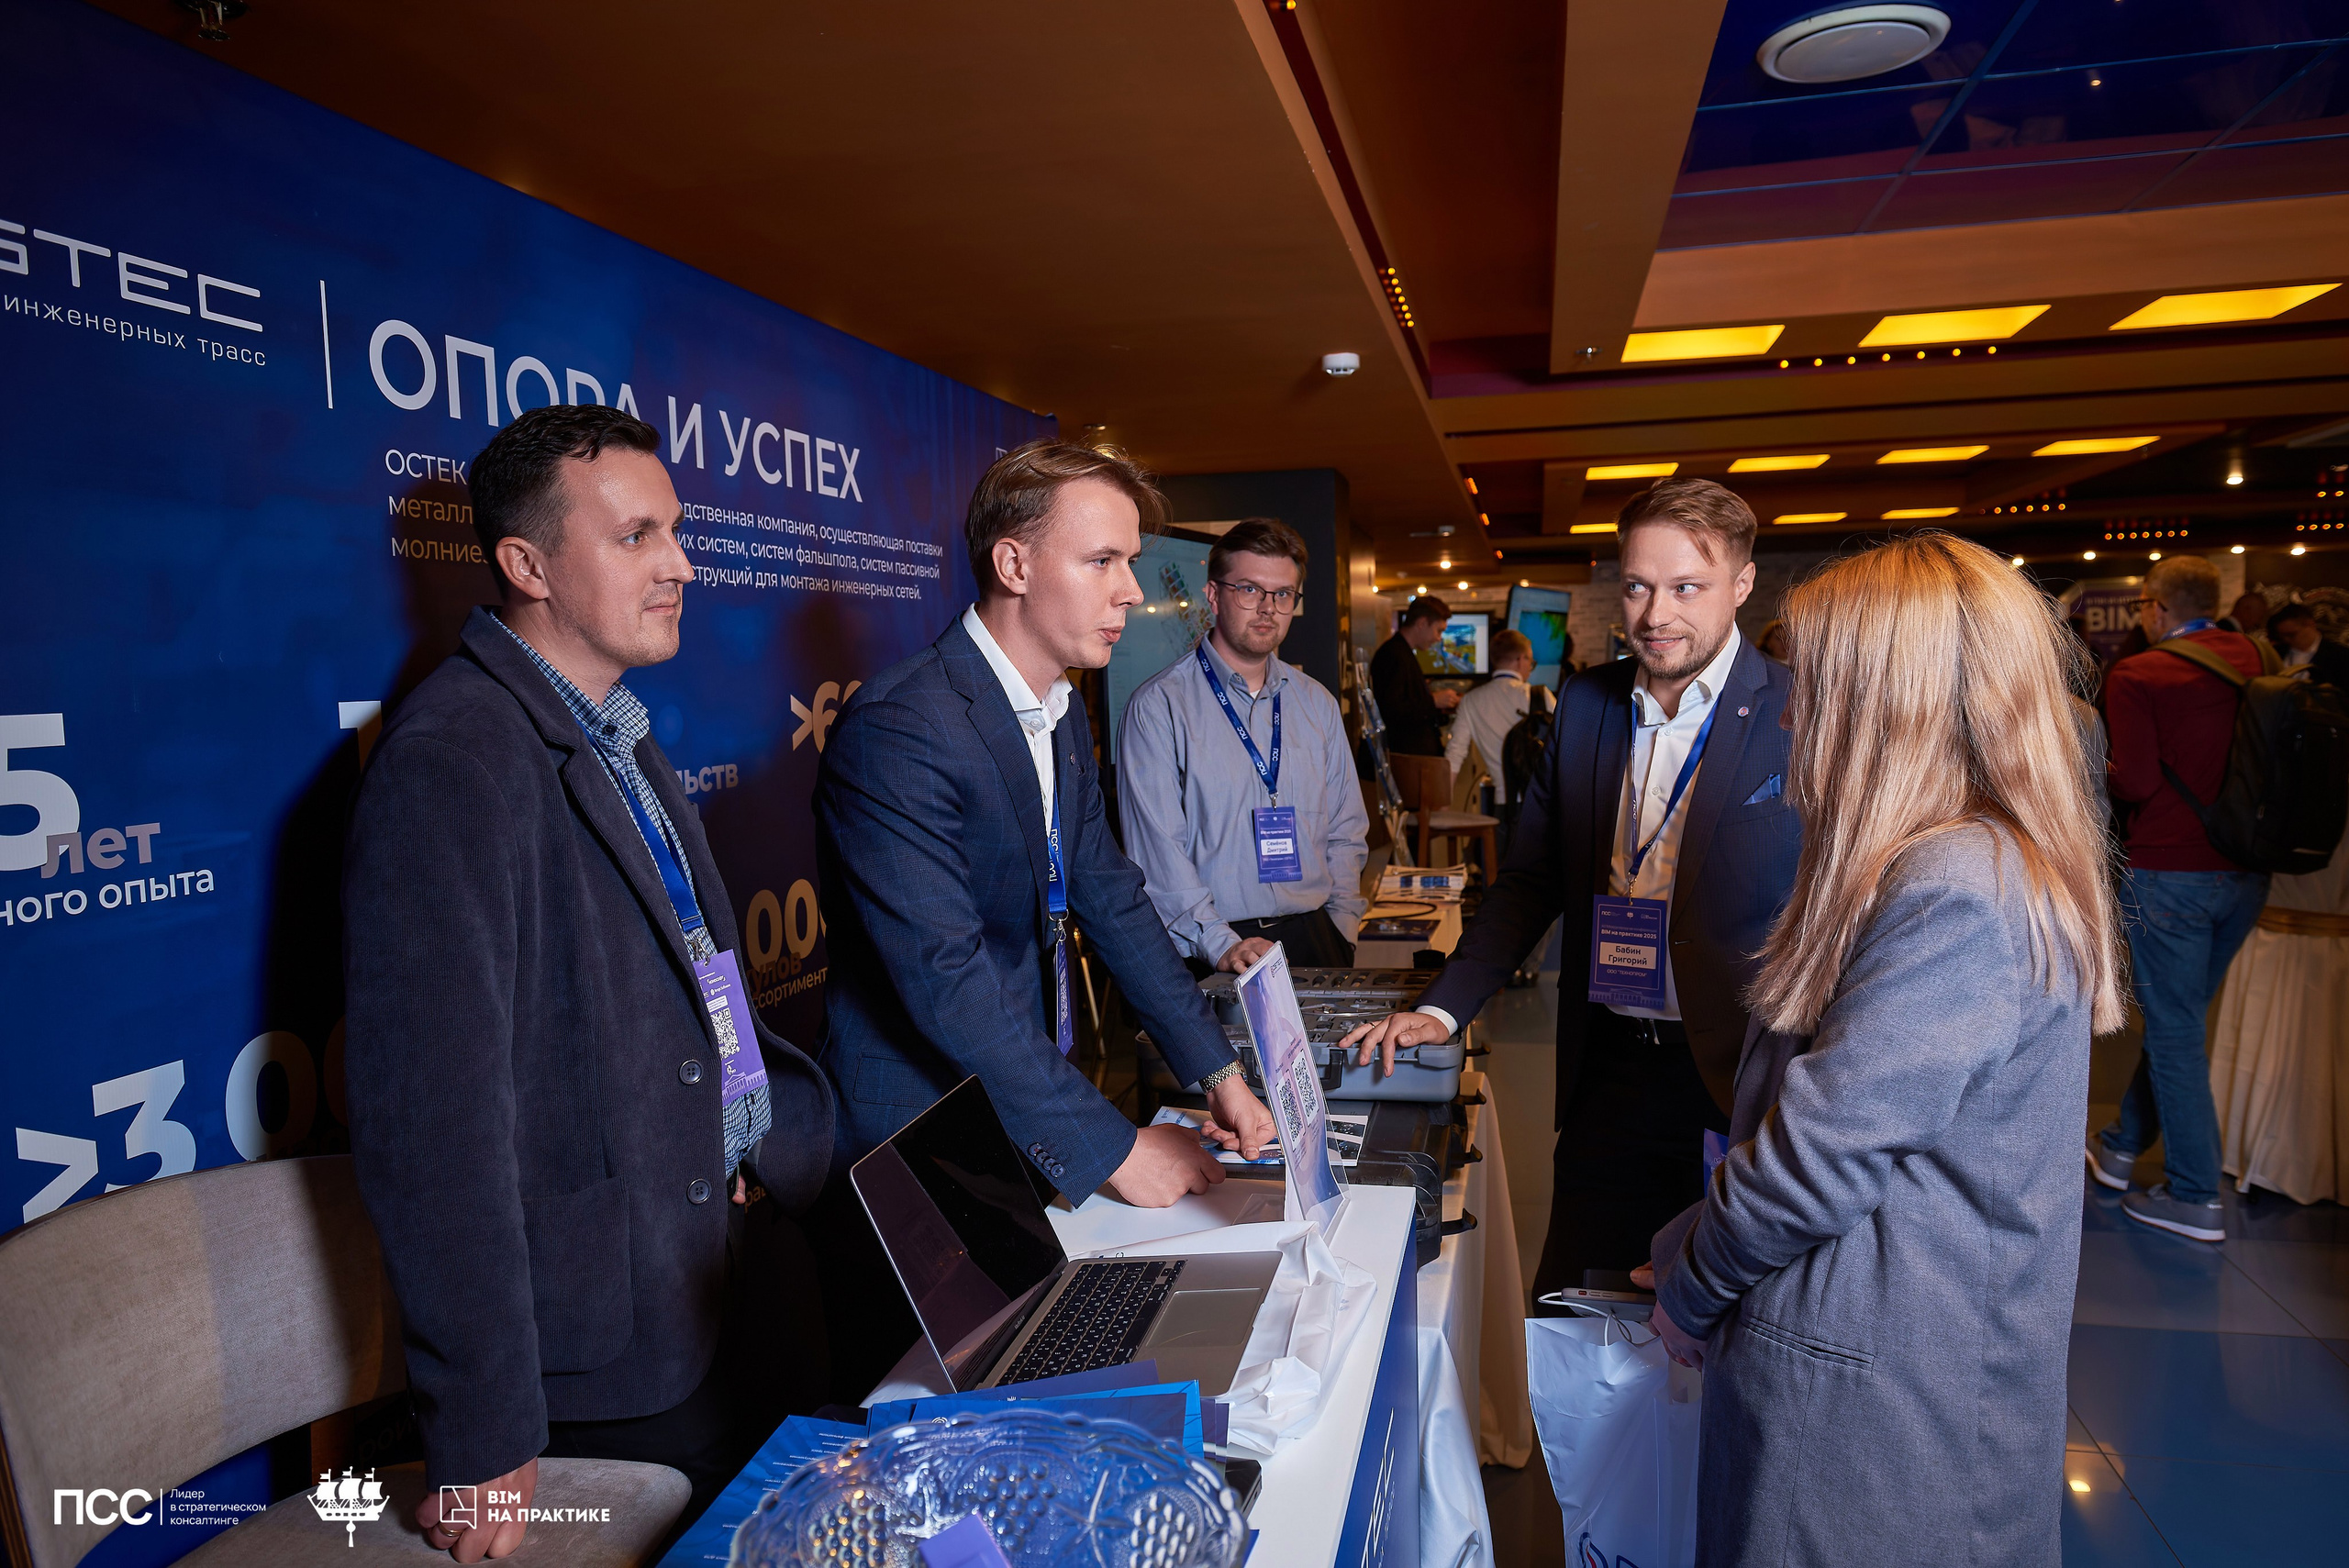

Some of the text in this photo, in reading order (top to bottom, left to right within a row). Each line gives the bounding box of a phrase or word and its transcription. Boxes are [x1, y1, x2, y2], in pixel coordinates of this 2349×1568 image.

[4, 294, 266, 366] инженерных трасс
[668, 395, 705, 470] И
[719, 409, 863, 503] УСПЕХ
[385, 449, 467, 485] ОСТЕК
[757, 515, 818, 540] компания,
[819, 526, 904, 551] осуществляющая
[906, 540, 942, 558] поставки
[388, 495, 941, 580] металл их систем, систем фальшпола, систем пассивной
[391, 537, 489, 565] молние
[755, 572, 778, 589] для
[781, 574, 829, 592] монтажа
[832, 579, 895, 599] инженерных
[896, 584, 922, 600] сетей.
[790, 680, 863, 753] >6
[675, 763, 739, 795] ьств
[40, 822, 161, 878] лет
[99, 869, 215, 909] опыта
[746, 878, 827, 973] 00
[1615, 946, 1641, 955] Бабин
[1608, 955, 1647, 965] Григорий
